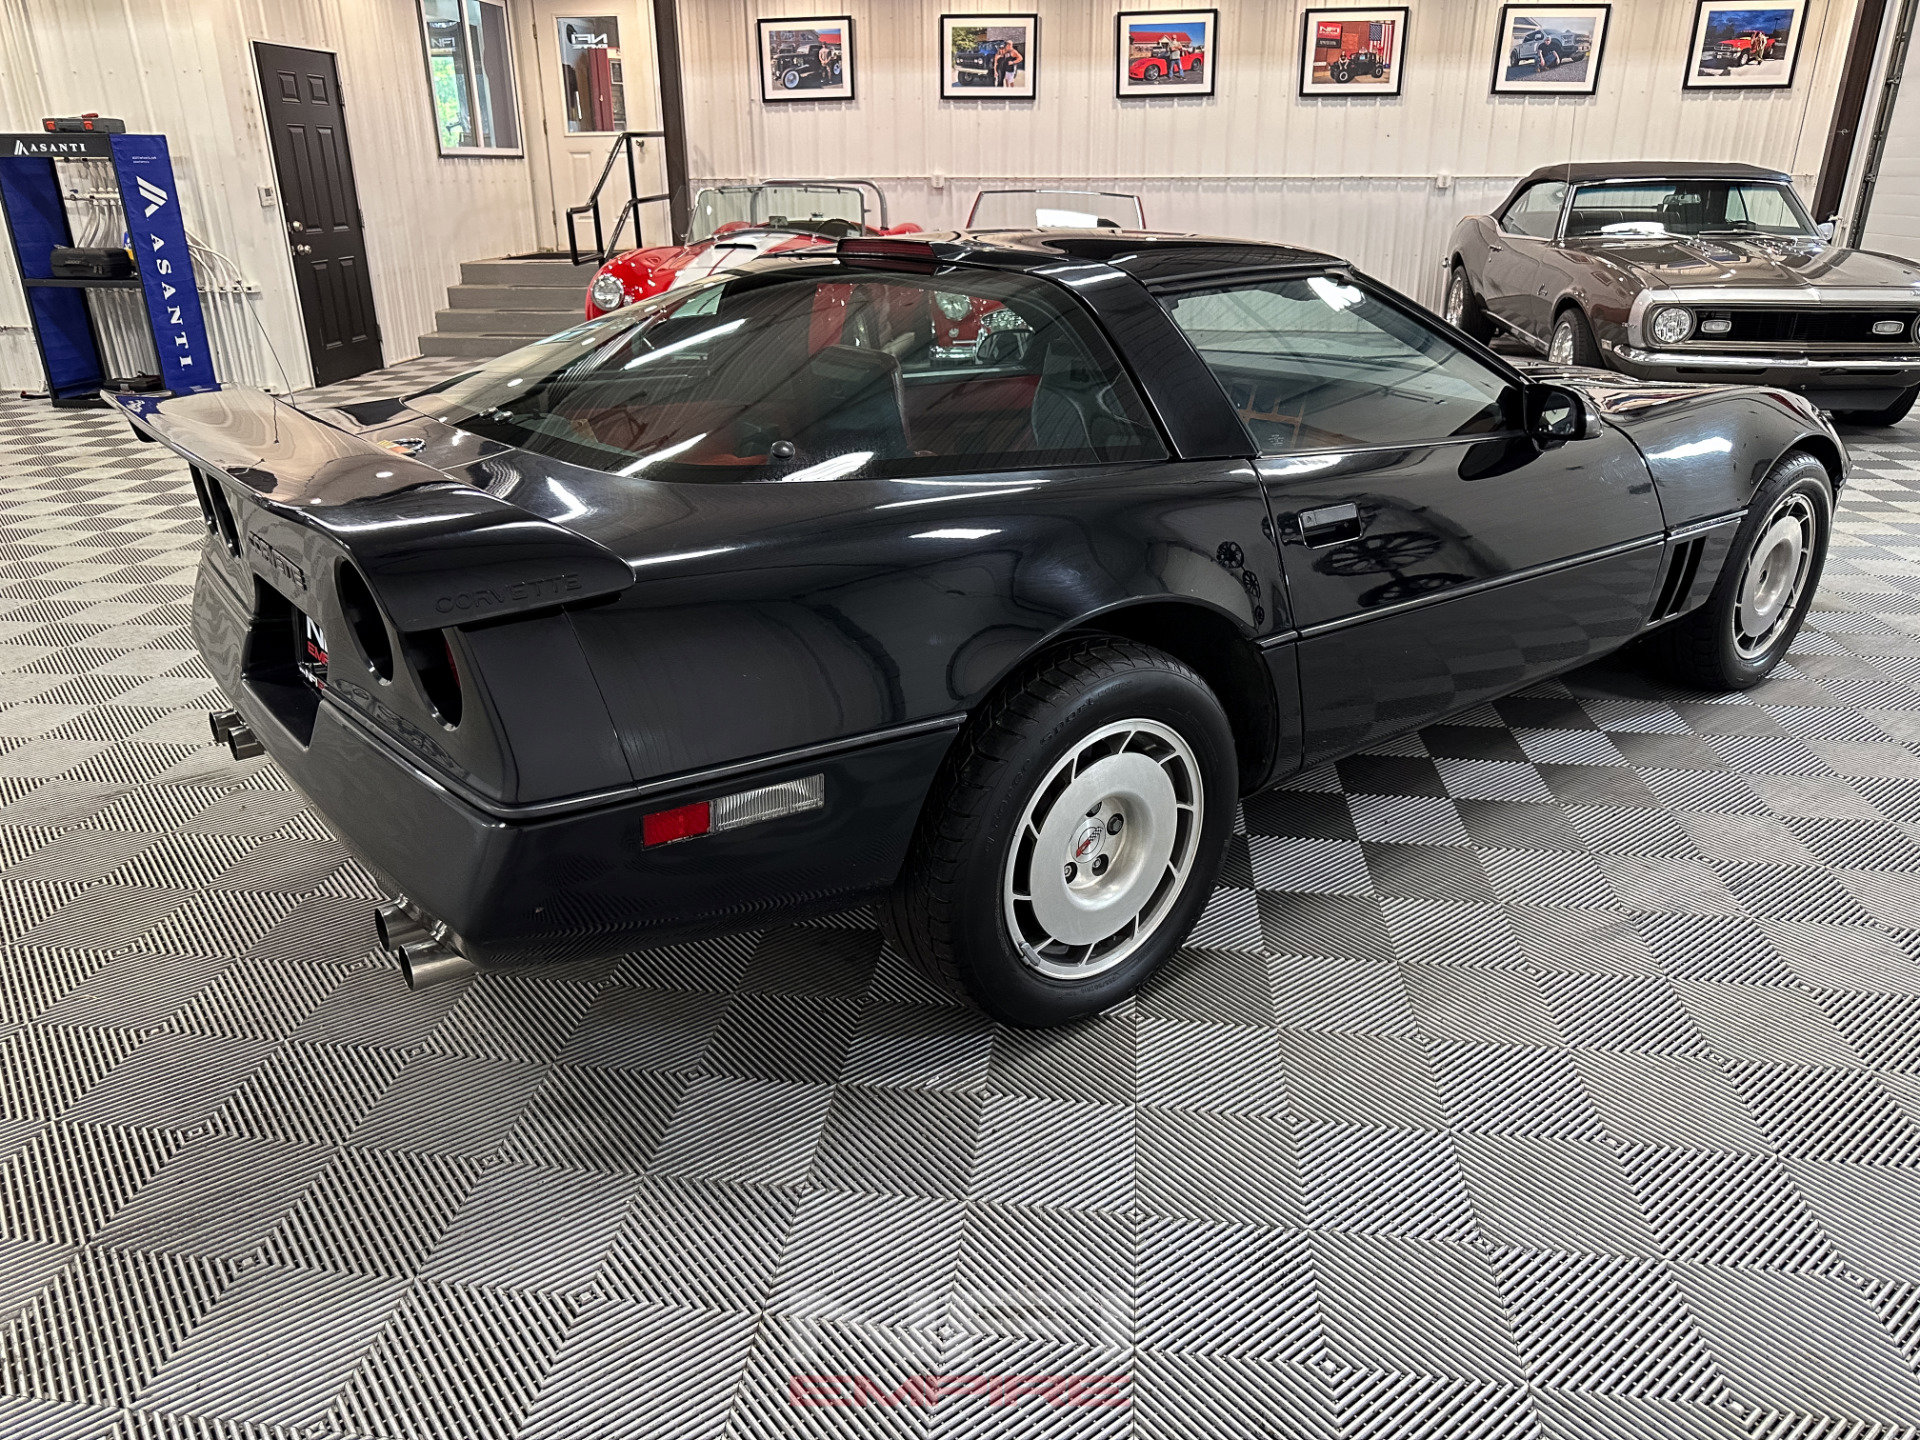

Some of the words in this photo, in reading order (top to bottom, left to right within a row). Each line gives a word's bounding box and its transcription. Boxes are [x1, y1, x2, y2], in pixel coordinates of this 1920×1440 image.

[30, 143, 88, 152] ASANTI
[150, 233, 193, 368] ASANTI
[434, 572, 583, 614] CORVETTE
